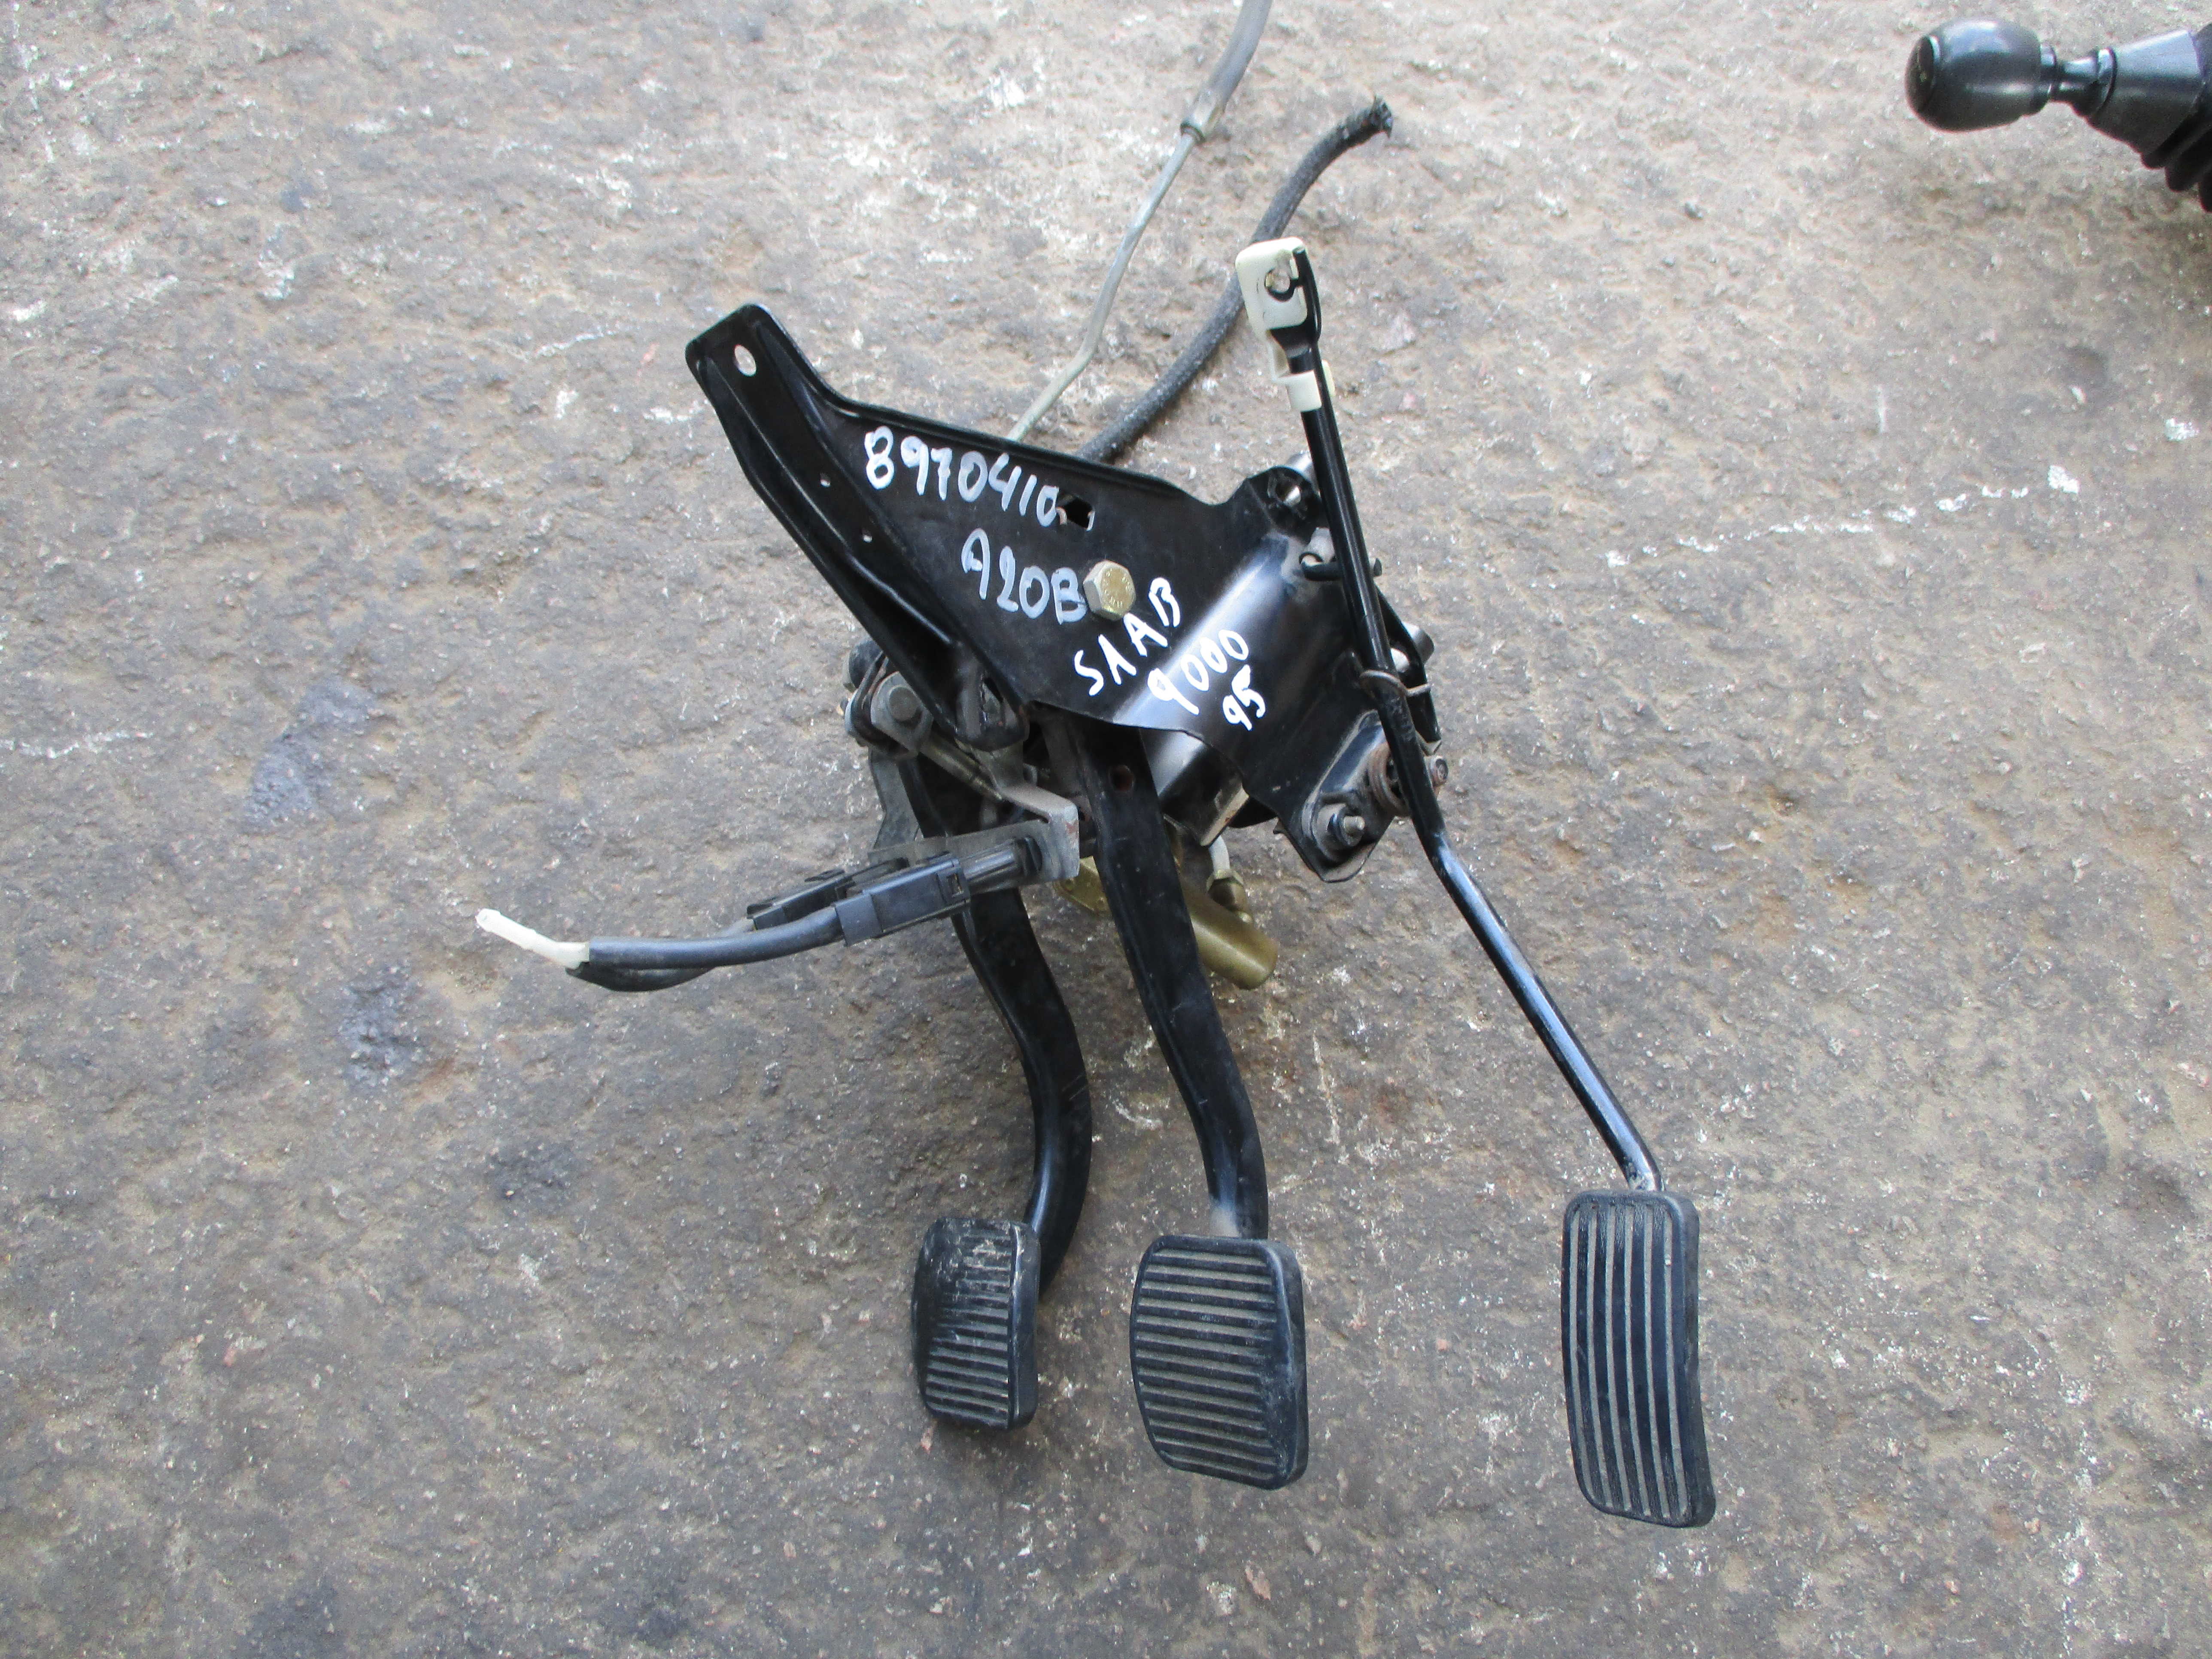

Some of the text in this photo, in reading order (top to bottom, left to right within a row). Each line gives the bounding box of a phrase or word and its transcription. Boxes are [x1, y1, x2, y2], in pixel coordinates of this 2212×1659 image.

[864, 426, 1059, 527] 8970410
[961, 528, 1087, 625] A20B
[1074, 577, 1180, 696] SAAB
[1148, 629, 1249, 715] 9000
[1222, 664, 1266, 730] 95
